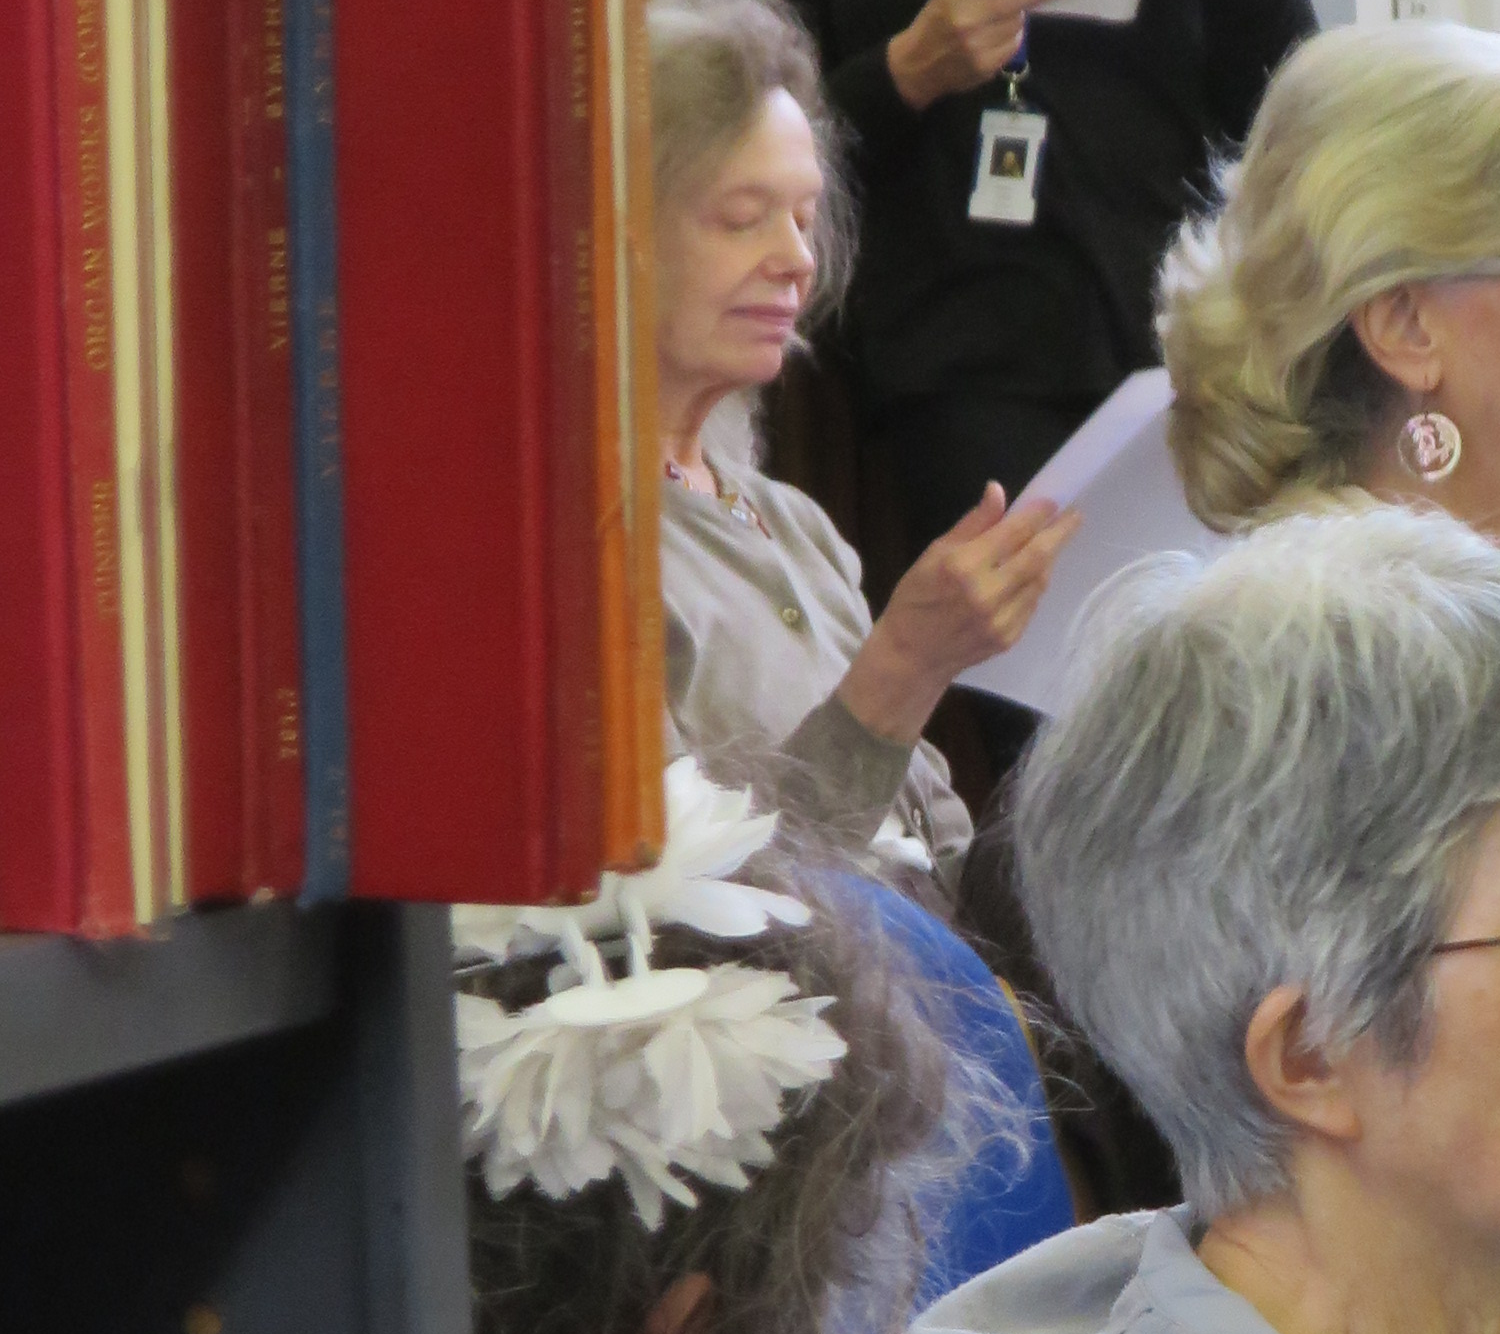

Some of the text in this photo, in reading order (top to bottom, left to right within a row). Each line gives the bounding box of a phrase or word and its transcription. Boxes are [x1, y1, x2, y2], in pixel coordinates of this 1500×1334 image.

[78, 106, 105, 234] WORKS
[82, 247, 109, 373] ORGAN
[267, 227, 288, 351] VIERNE
